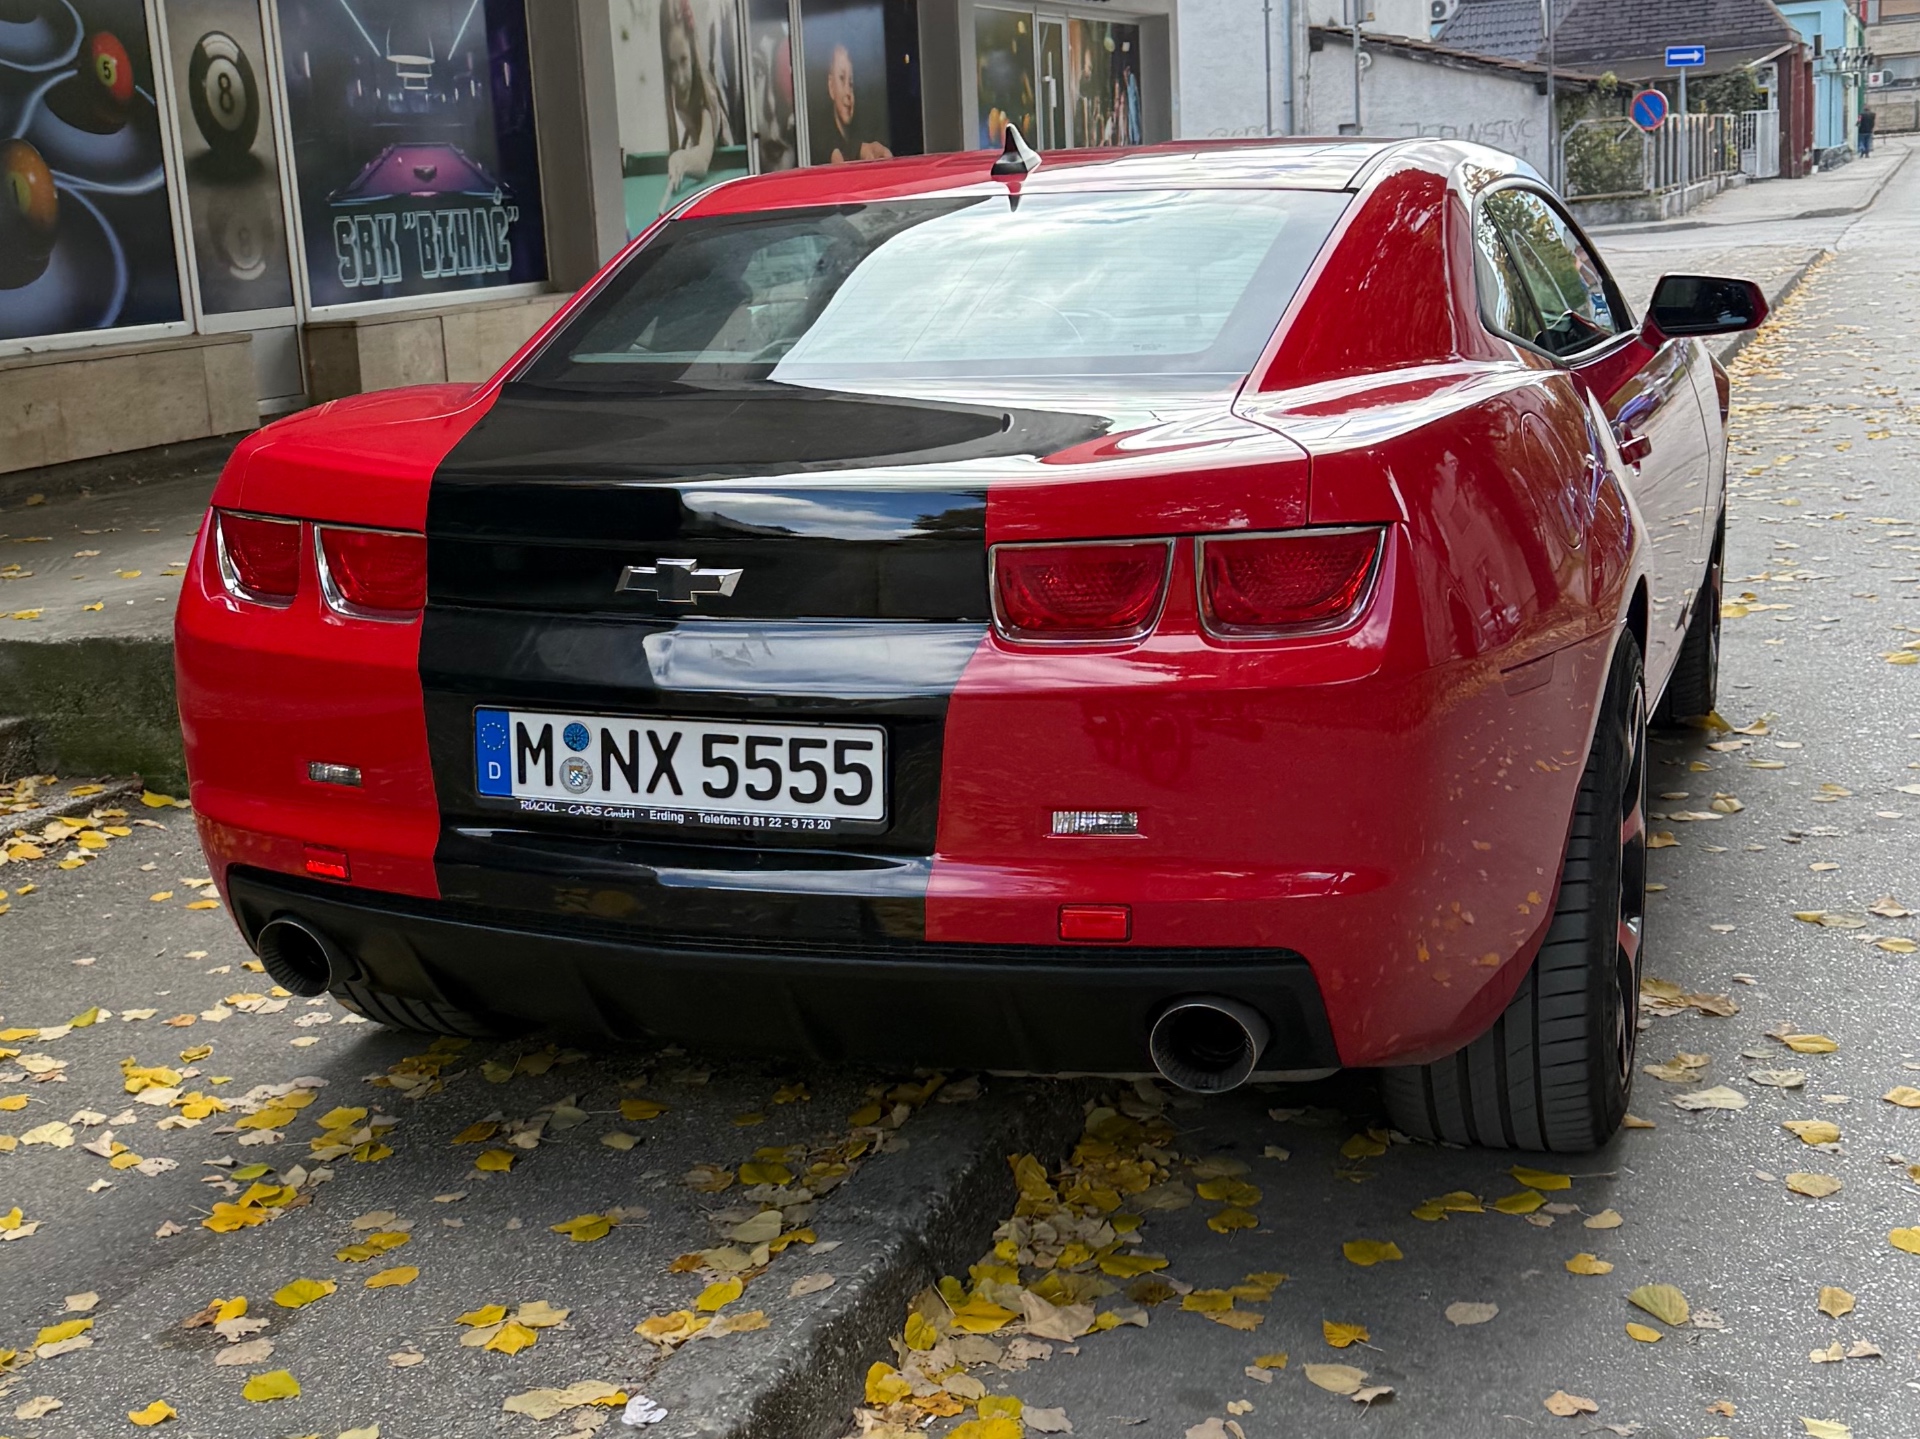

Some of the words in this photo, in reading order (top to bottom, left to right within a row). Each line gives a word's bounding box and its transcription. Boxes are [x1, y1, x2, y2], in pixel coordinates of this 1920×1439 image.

[102, 60, 112, 80] 5
[217, 72, 236, 114] 8
[333, 213, 402, 287] SBK
[488, 761, 502, 780] D
[516, 721, 554, 787] M
[601, 727, 684, 796] NX
[702, 733, 873, 806] 5555
[519, 799, 560, 813] RÜCKL
[568, 804, 602, 816] CARS
[604, 807, 635, 818] GmbH
[649, 810, 685, 824] Erding
[698, 813, 741, 826] Telefon:
[743, 816, 750, 827] 0
[752, 816, 765, 827] 81
[768, 817, 782, 828] 22
[791, 818, 799, 828] 9
[801, 818, 815, 829] 73
[817, 819, 831, 830] 20
